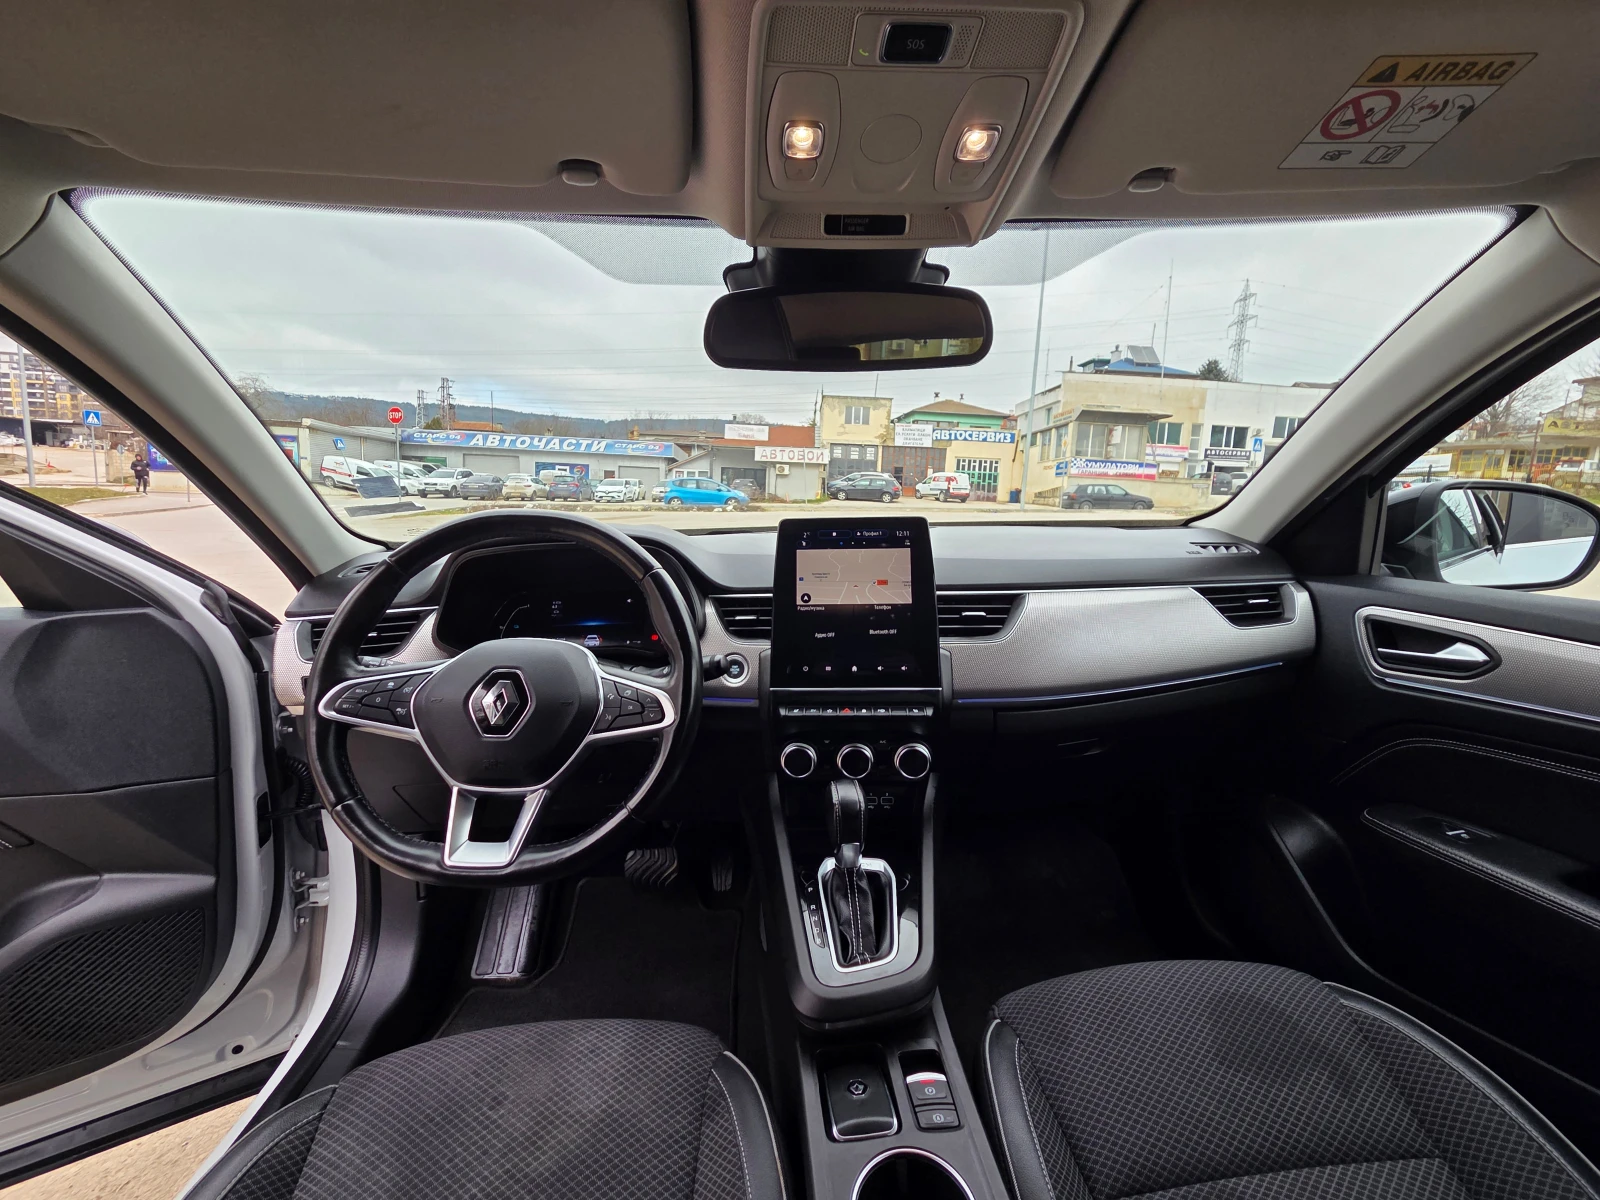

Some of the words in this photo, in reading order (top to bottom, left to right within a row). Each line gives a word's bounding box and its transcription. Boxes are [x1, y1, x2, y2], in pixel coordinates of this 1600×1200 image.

[907, 38, 925, 50] SOS
[1403, 60, 1516, 82] AIRBAG
[389, 411, 402, 420] STOP
[469, 433, 608, 452] АВТОЧАСТИ
[932, 430, 1012, 443] АВТОСЕРВИЗ
[760, 449, 824, 462] АВТОБОИ
[1075, 461, 1140, 471] АКУМУЛАТОРИ
